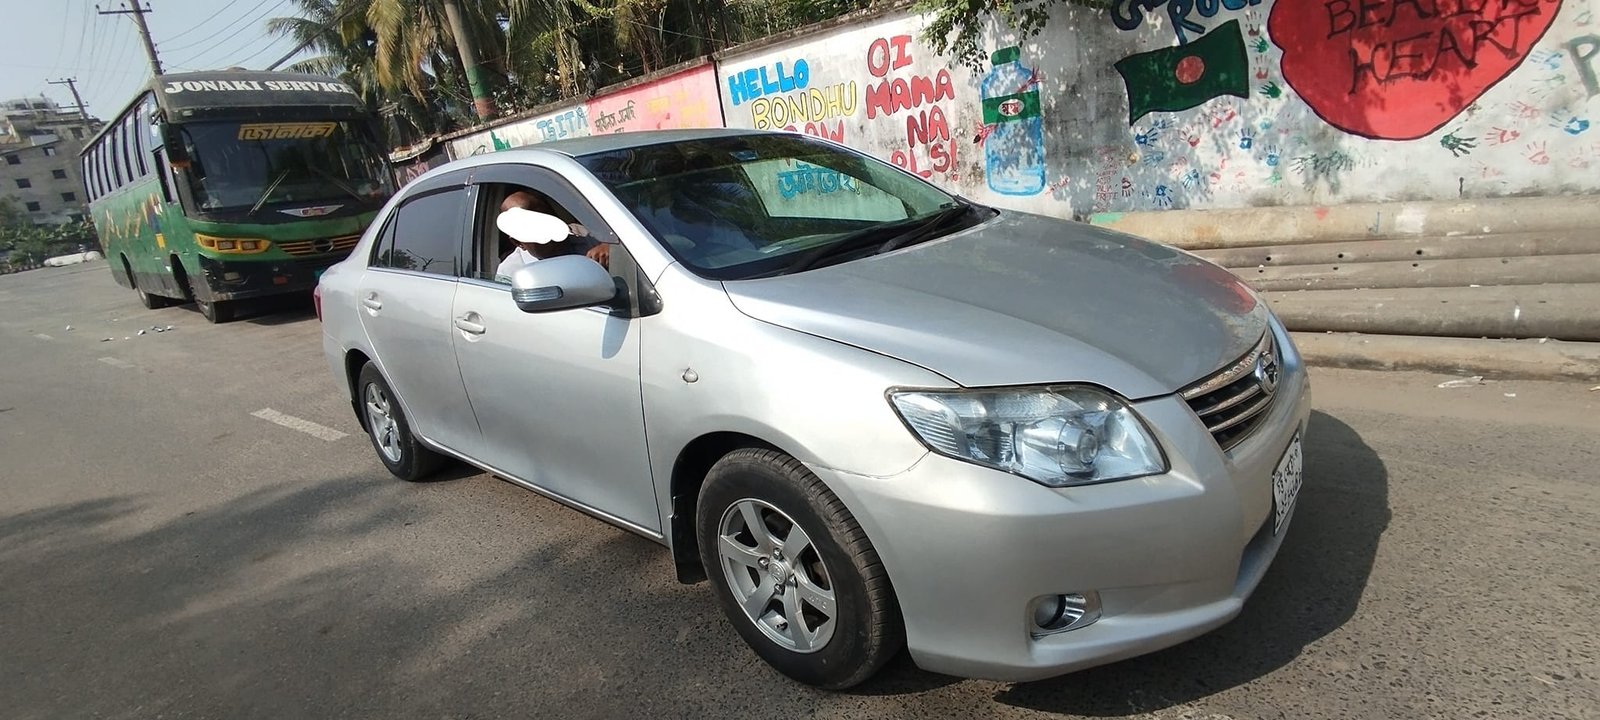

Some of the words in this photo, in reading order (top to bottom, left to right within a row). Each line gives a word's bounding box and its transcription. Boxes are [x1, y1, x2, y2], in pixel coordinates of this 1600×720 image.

[867, 35, 913, 77] OI
[1347, 6, 1542, 95] HEART
[164, 80, 264, 94] JONAKI
[728, 58, 809, 106] HELLO
[752, 80, 857, 130] BONDHU
[866, 68, 955, 119] MAMA
[907, 105, 950, 148] NA
